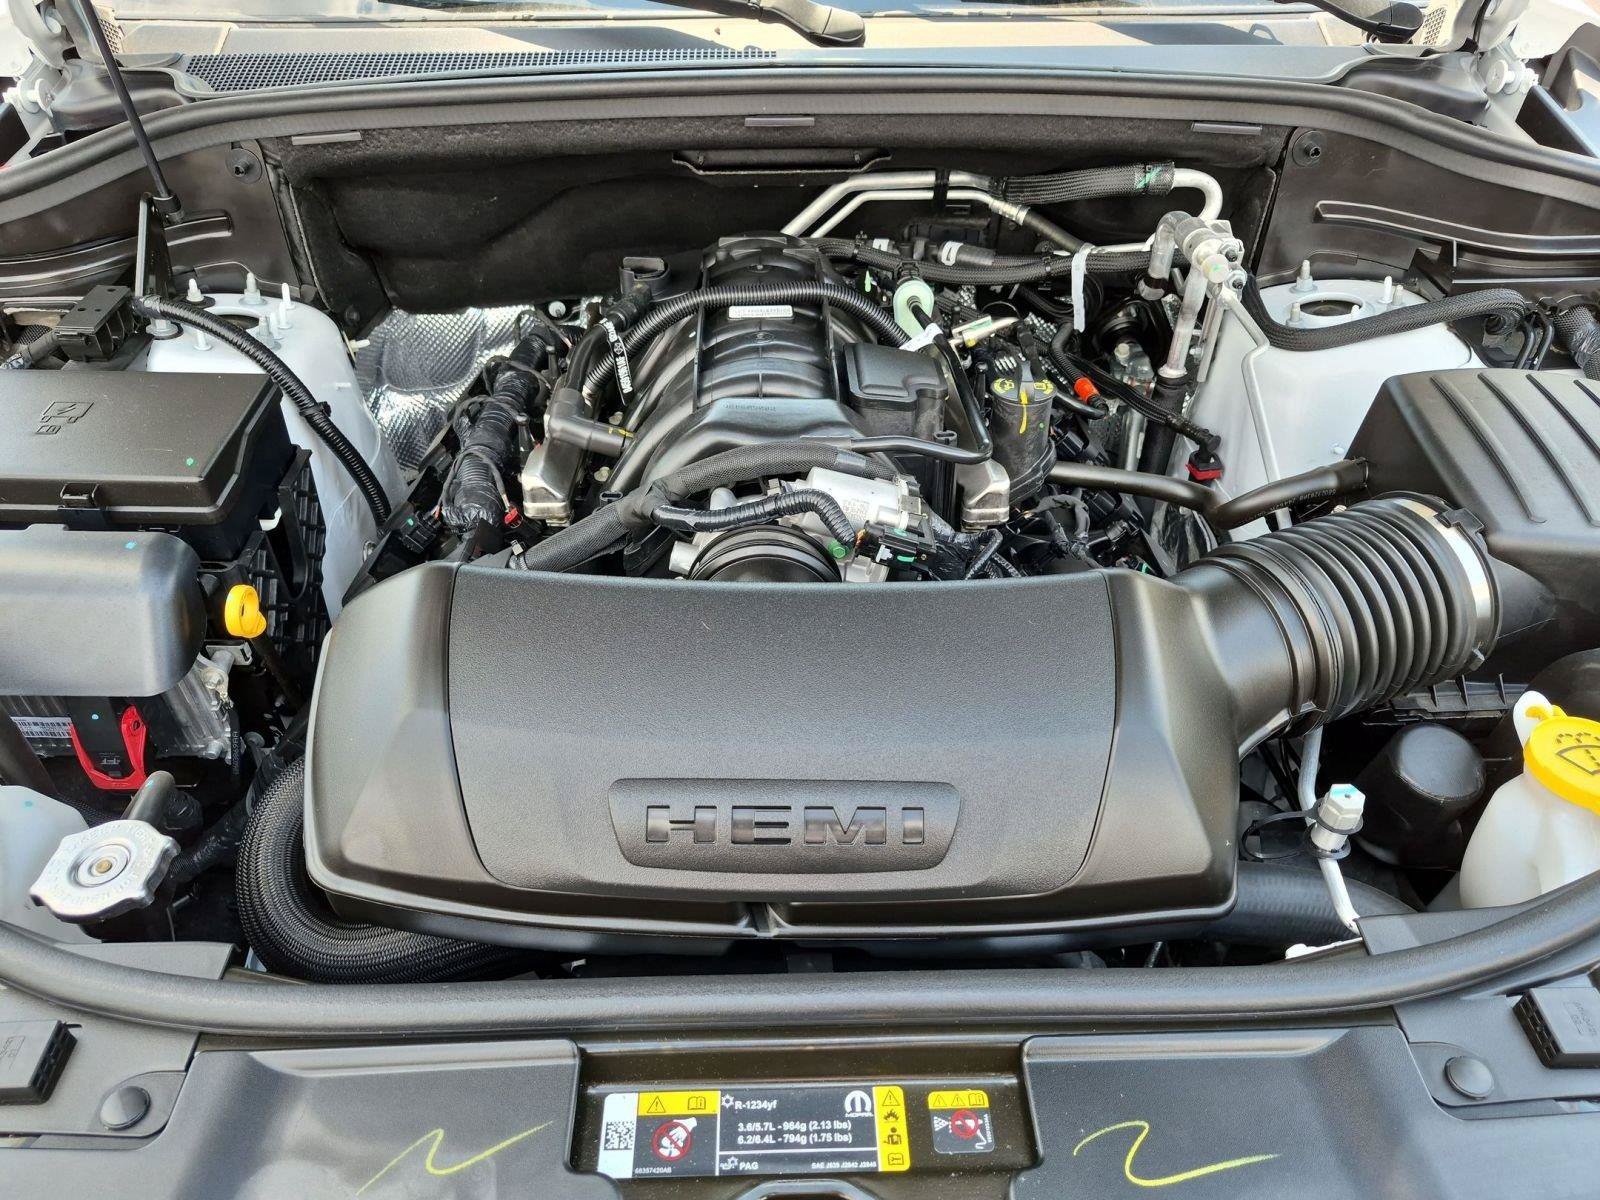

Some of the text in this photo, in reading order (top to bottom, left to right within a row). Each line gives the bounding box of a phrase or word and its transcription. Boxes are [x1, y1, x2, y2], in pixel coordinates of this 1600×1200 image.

[646, 805, 924, 845] HEMI
[734, 1099, 778, 1111] R-1234yf
[737, 1121, 776, 1132] 3.6/5.7L
[808, 1120, 832, 1132] (2.13
[833, 1119, 852, 1131] lbs)
[737, 1134, 776, 1145] 6.2/6.4L
[782, 1133, 807, 1145] 794g
[809, 1133, 832, 1145] (1.75
[834, 1132, 853, 1144] lbs)
[739, 1161, 759, 1170] PAG
